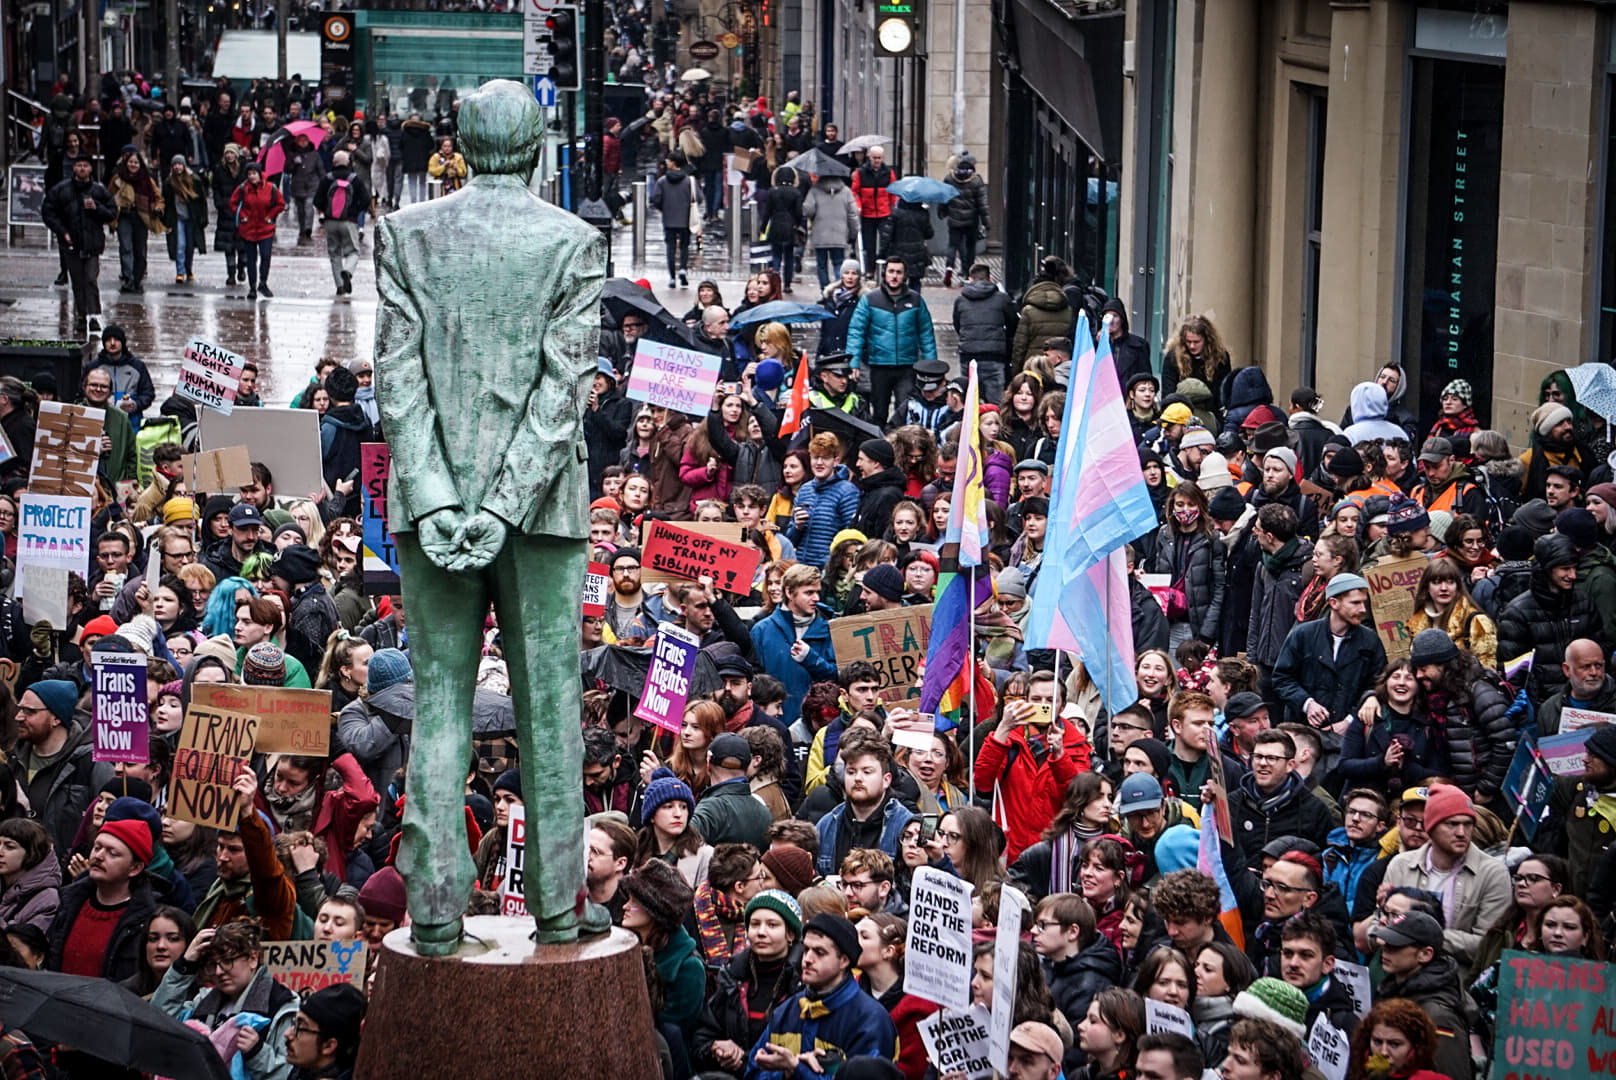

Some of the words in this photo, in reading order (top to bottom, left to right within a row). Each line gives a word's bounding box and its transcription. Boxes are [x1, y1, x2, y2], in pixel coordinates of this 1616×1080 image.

[1453, 129, 1468, 222] STREET
[1448, 238, 1464, 368] BUCHANAN
[191, 351, 231, 376] RIGHTS
[194, 342, 235, 366] TRANS
[656, 346, 704, 368] TRANS
[653, 358, 697, 378] RIGHTS
[660, 373, 687, 387] ARE
[183, 382, 223, 407] RIGHTS
[185, 371, 226, 397] HUMAN
[648, 381, 697, 402] HUMAN
[648, 392, 694, 412] RIGHTS
[23, 504, 87, 529] PROTECT
[22, 533, 84, 552] TRANS
[654, 526, 689, 546] HANDS
[692, 539, 714, 551] OFF
[720, 547, 739, 559] MY
[672, 546, 717, 565] TRANS
[584, 574, 605, 585] TECT
[584, 584, 599, 594] ANS
[1367, 573, 1393, 595] NO
[583, 593, 600, 603] HTS
[655, 631, 687, 668] Trans
[852, 615, 932, 659] TRAN
[93, 664, 136, 693] Trans
[650, 658, 689, 697] Rights
[96, 693, 147, 728] Rights
[643, 683, 671, 717] Now
[97, 722, 132, 751] Now
[189, 711, 257, 757] TRANS
[171, 779, 240, 827] NOW
[915, 887, 959, 914] HANDS
[913, 920, 939, 941] GRA
[914, 904, 939, 923] OFF
[941, 912, 965, 934] THE
[911, 935, 967, 967] REFORM
[1508, 957, 1607, 993] TRANS
[1509, 997, 1584, 1032] HAVE
[1591, 1005, 1616, 1038] AL
[959, 1025, 989, 1044] THE
[1321, 1047, 1341, 1067] THE
[1505, 1035, 1575, 1070] USED
[1587, 1046, 1616, 1076] WO
